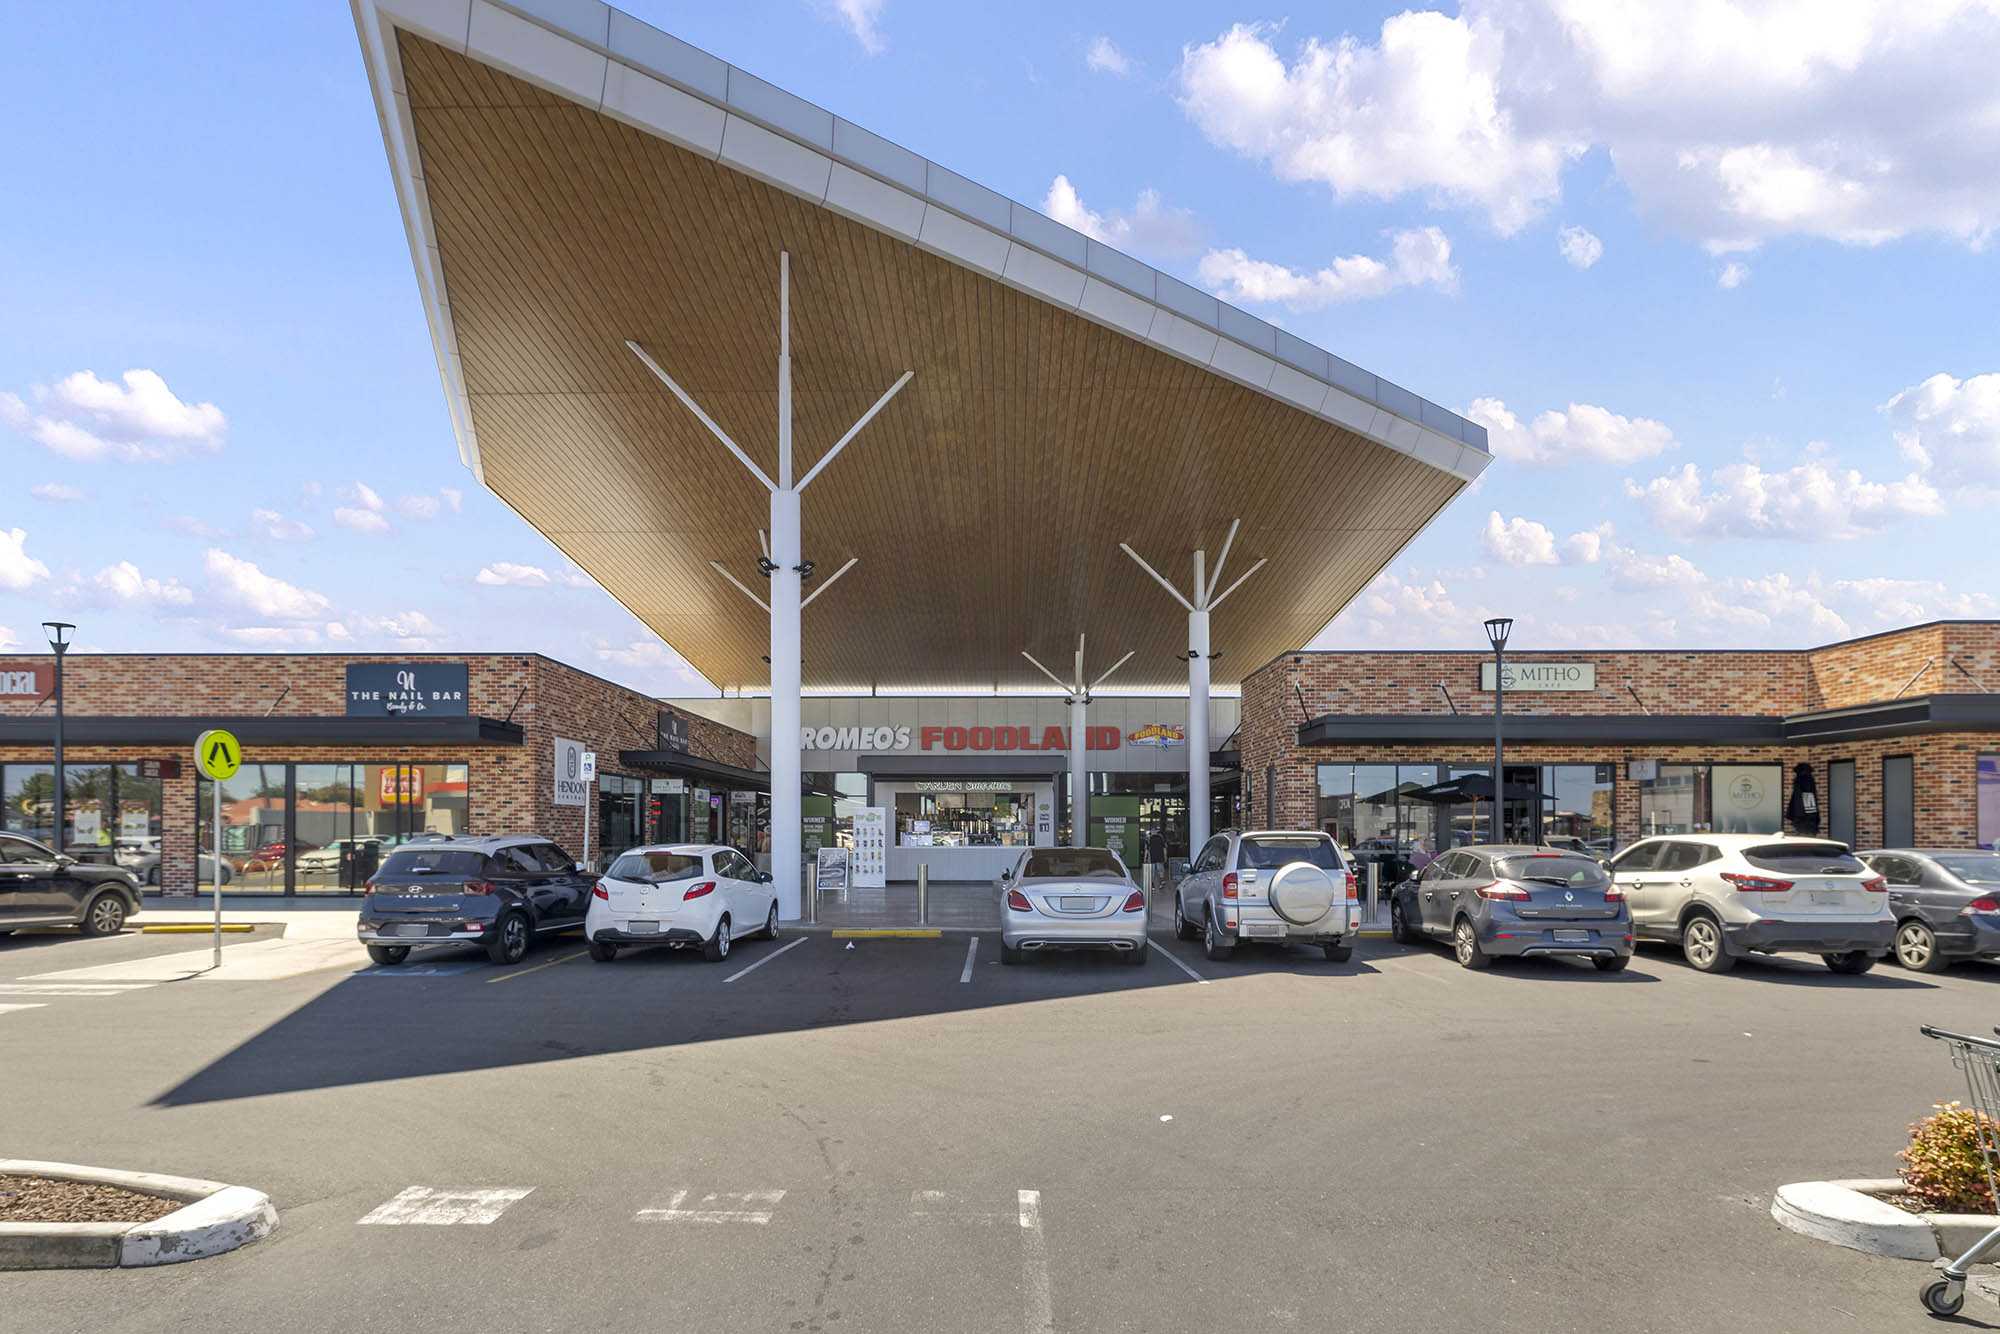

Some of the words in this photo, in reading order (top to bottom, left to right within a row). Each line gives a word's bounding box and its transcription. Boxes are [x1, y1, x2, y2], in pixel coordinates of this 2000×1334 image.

[1521, 666, 1580, 681] MITHO
[352, 691, 380, 700] THE
[389, 691, 424, 700] NAIL
[432, 691, 461, 700] BAR
[800, 724, 910, 750] ROMEO'S
[1134, 727, 1179, 739] FOODLAND
[558, 780, 585, 794] HENDON
